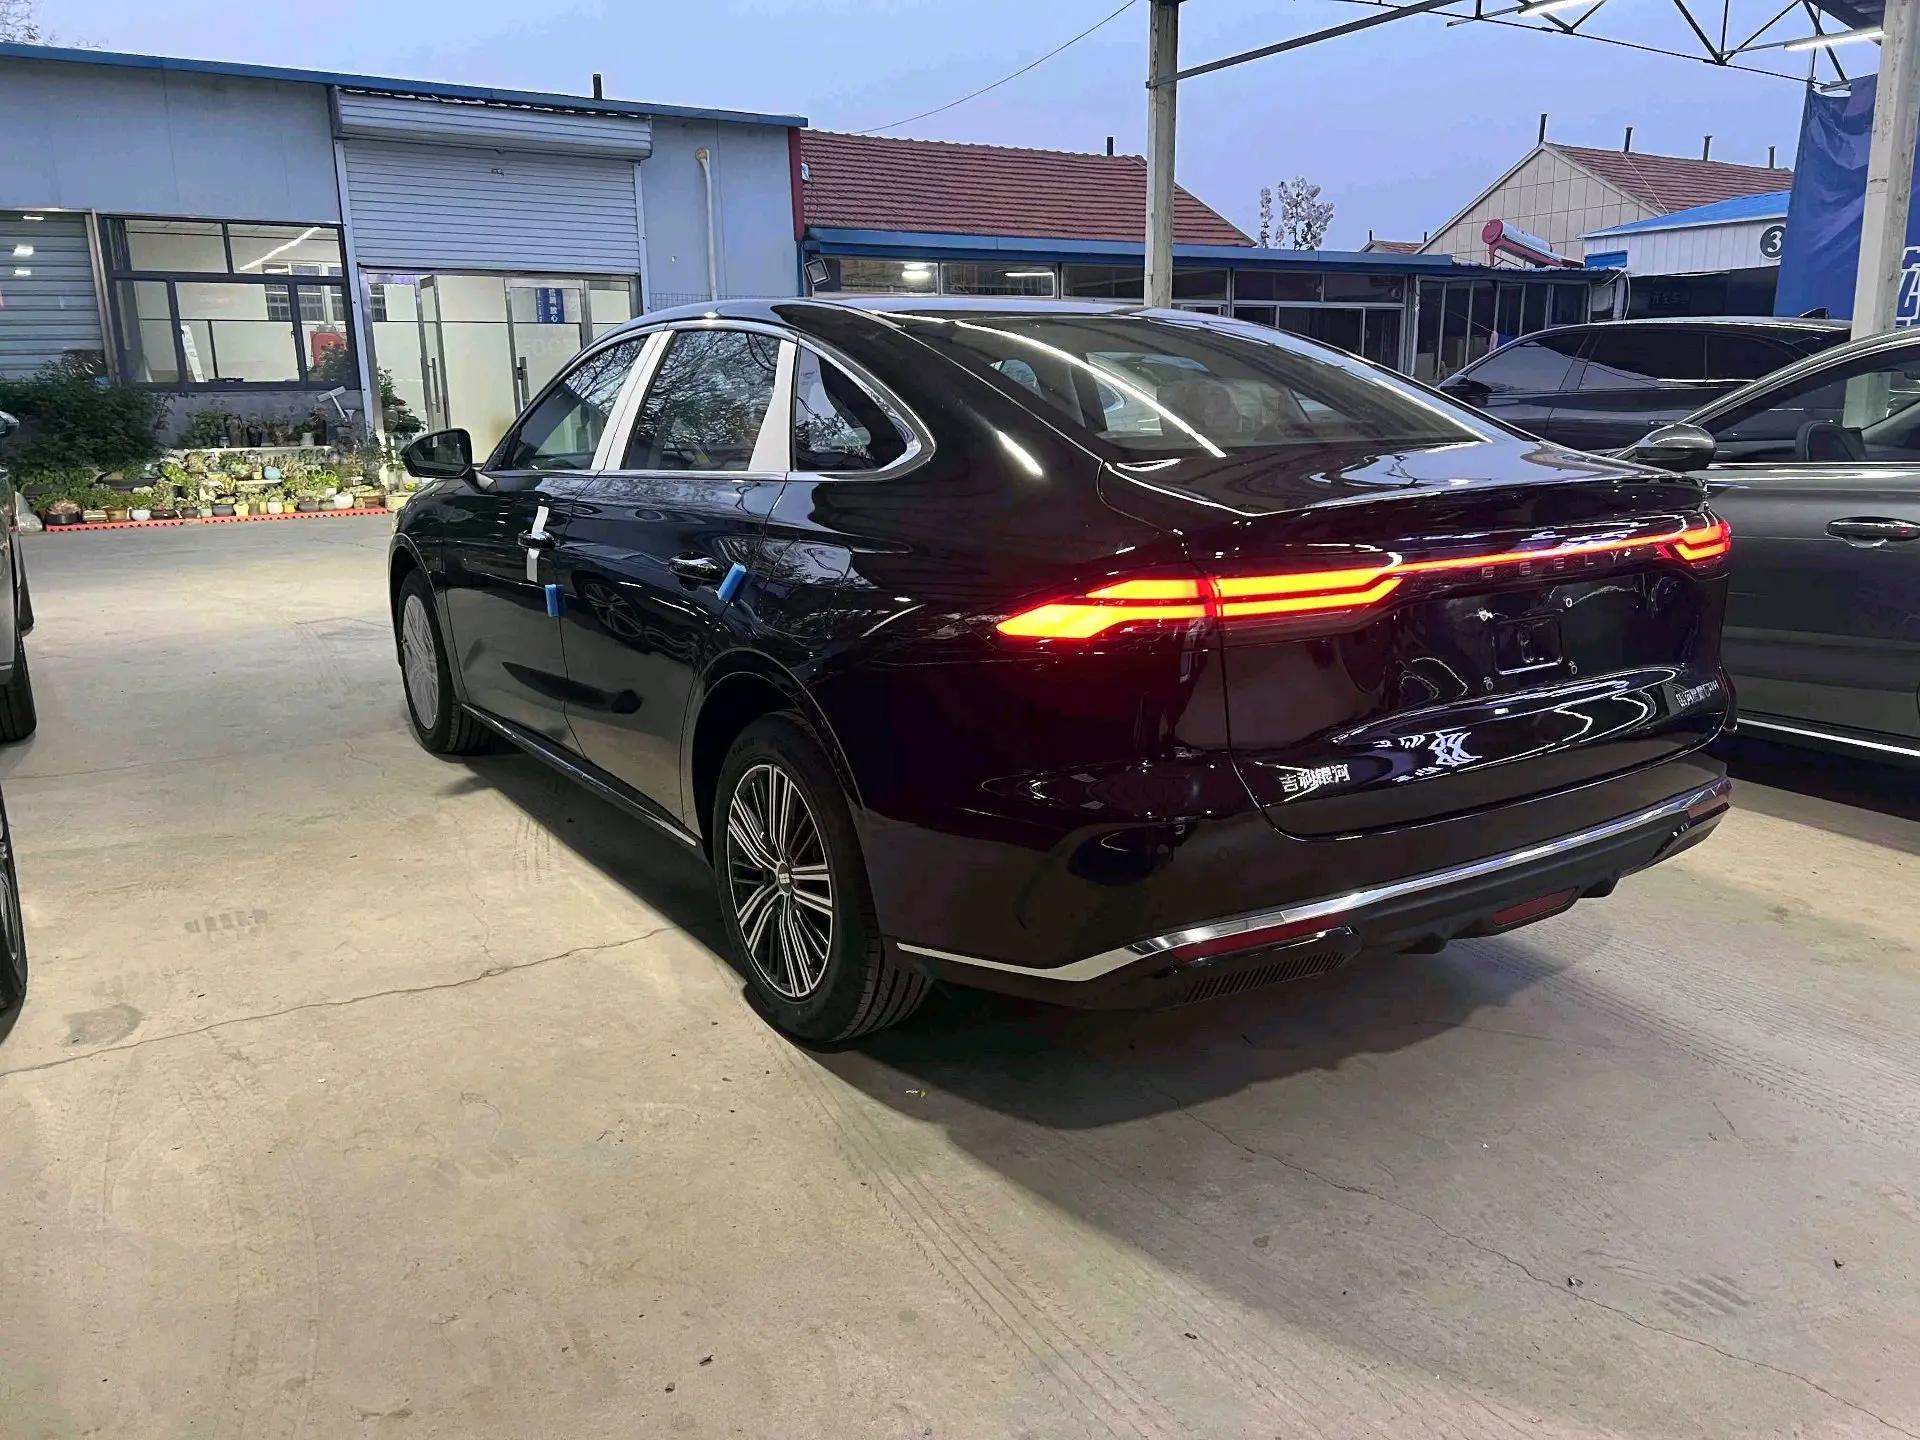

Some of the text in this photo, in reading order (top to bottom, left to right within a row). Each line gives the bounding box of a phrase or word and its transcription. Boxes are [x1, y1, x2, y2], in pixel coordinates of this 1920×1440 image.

[1767, 230, 1783, 253] 3
[1481, 551, 1619, 579] GEELY
[1279, 763, 1351, 792] 吉利银河
